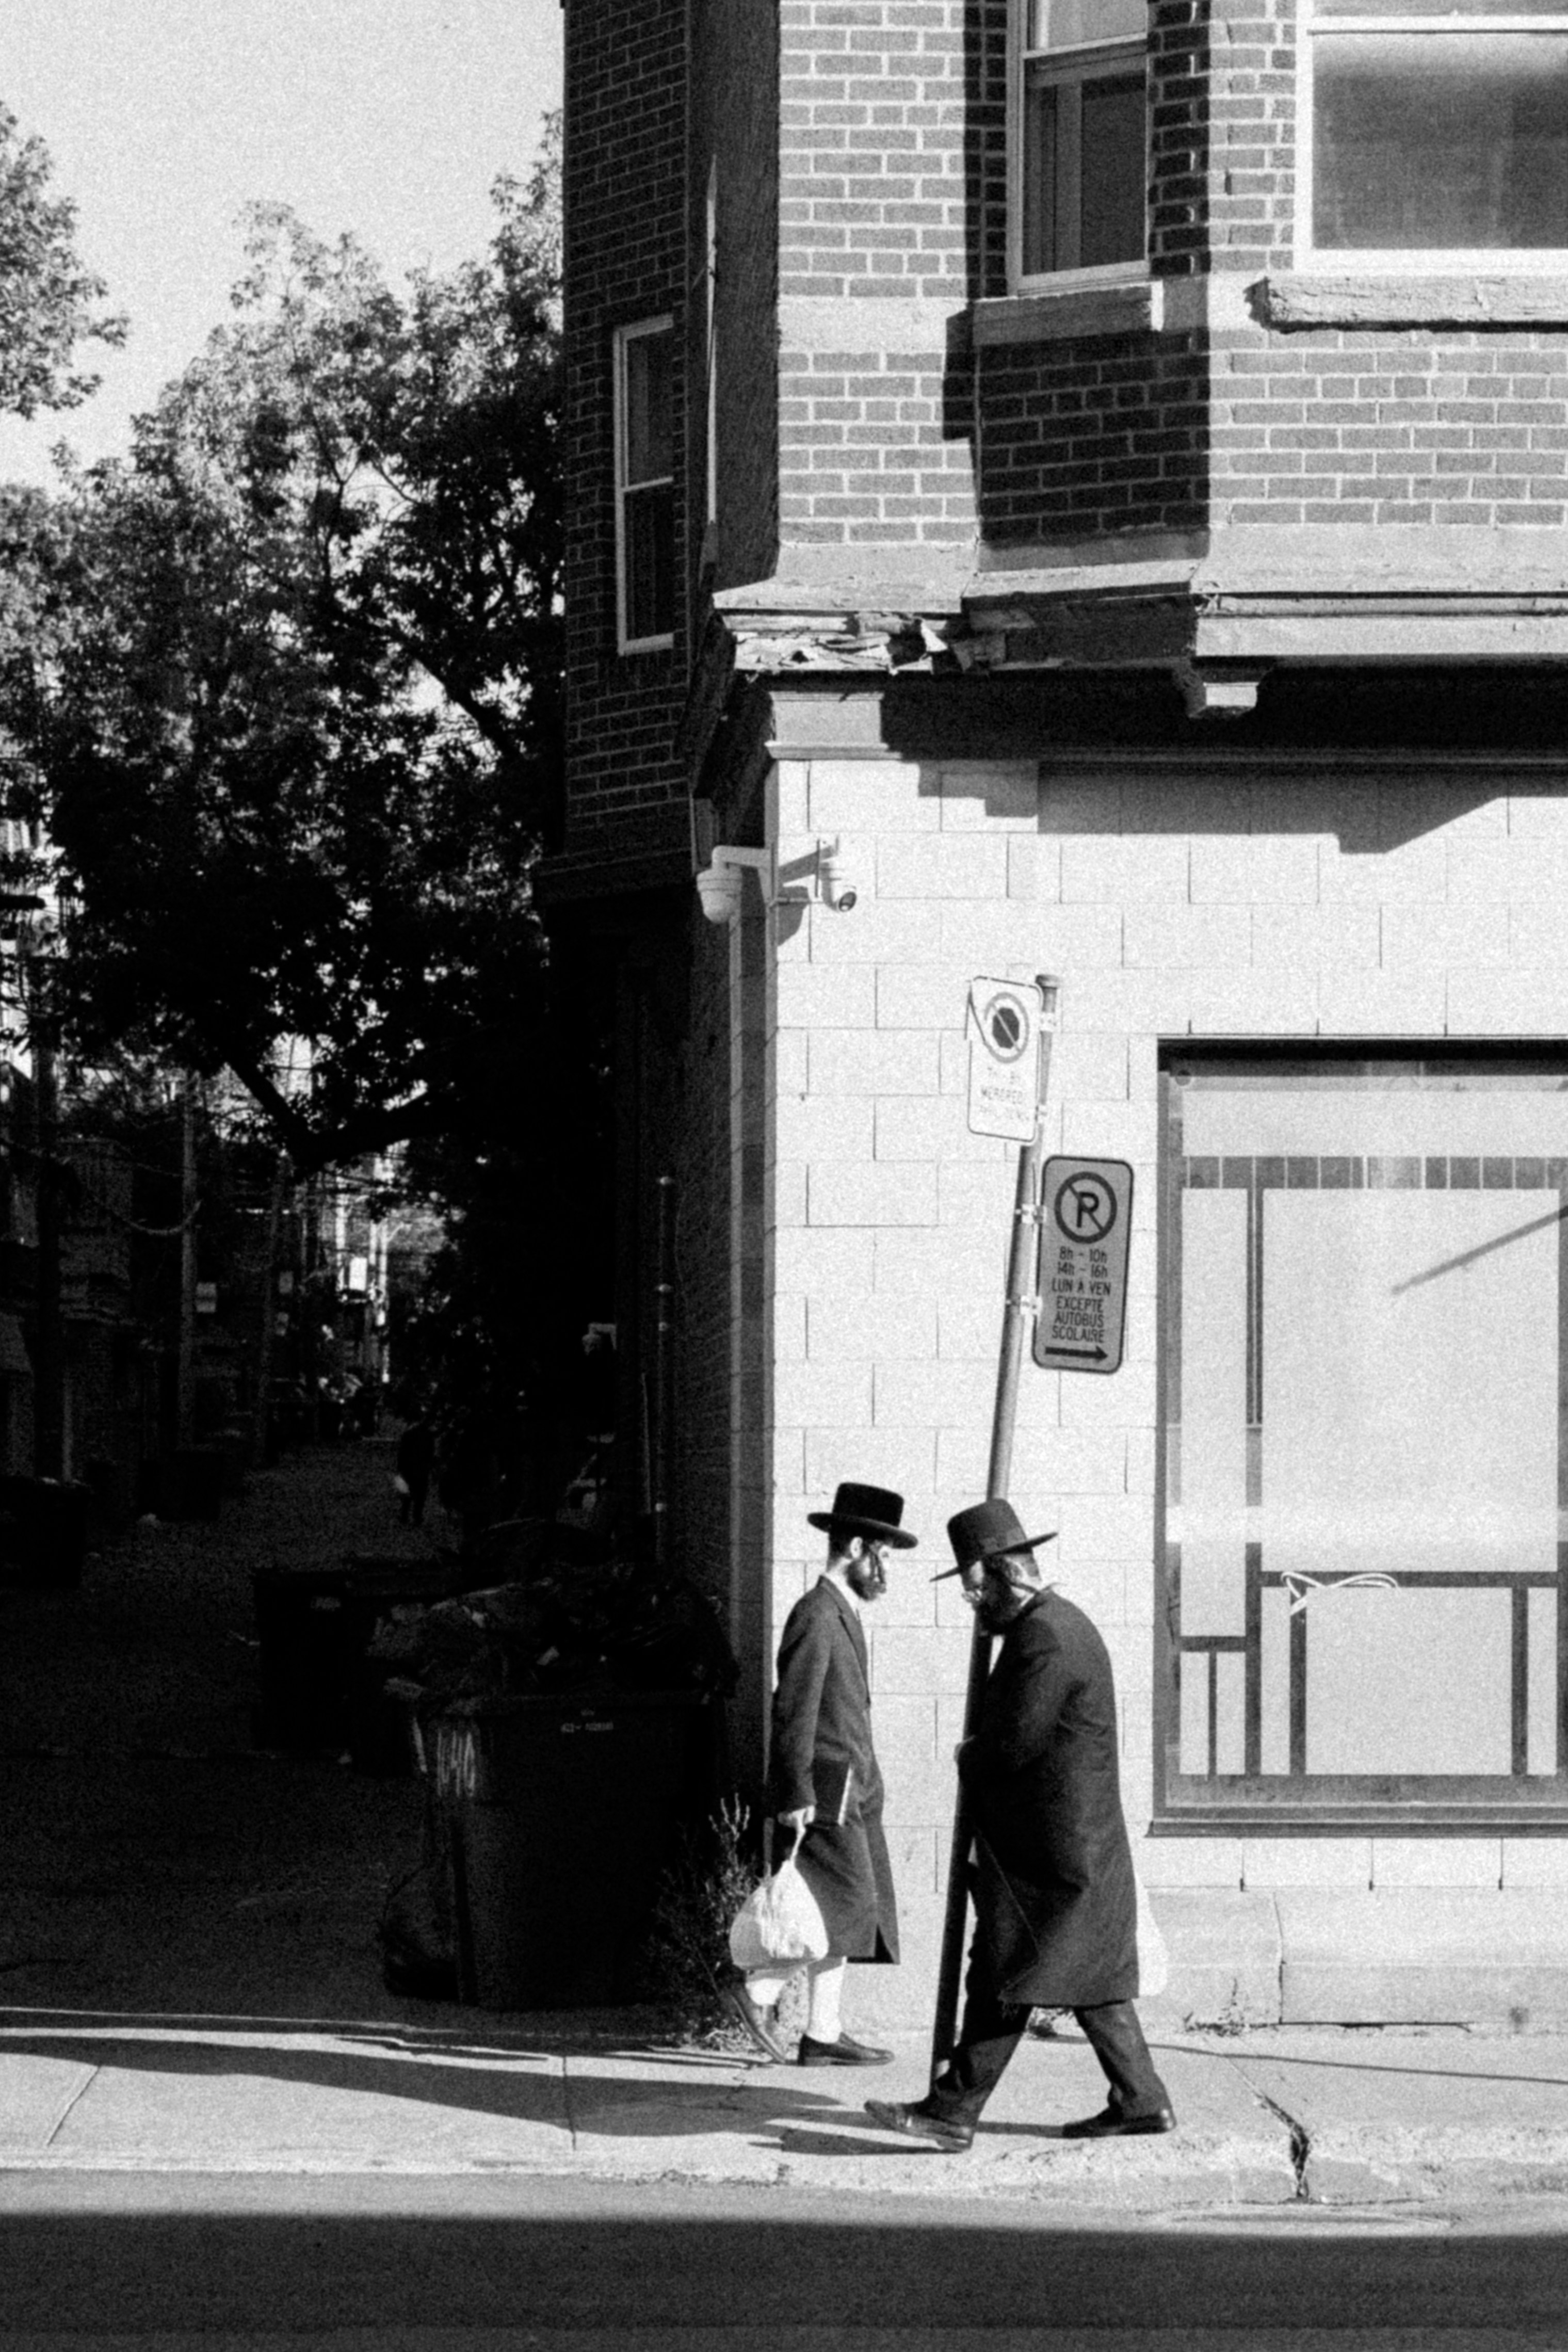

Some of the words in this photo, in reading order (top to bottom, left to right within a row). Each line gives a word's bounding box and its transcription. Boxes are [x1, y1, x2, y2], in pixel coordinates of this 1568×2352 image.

[1077, 1191, 1099, 1228] P
[1059, 1247, 1073, 1260] 8h
[1090, 1249, 1107, 1263] 10h
[1057, 1262, 1074, 1276] 14h
[1091, 1264, 1108, 1278] 16h
[1052, 1278, 1073, 1292] LUN
[1089, 1281, 1111, 1296] VEN
[1054, 1311, 1105, 1328] AUTOBUS
[1052, 1325, 1105, 1343] SCOLAIRE
